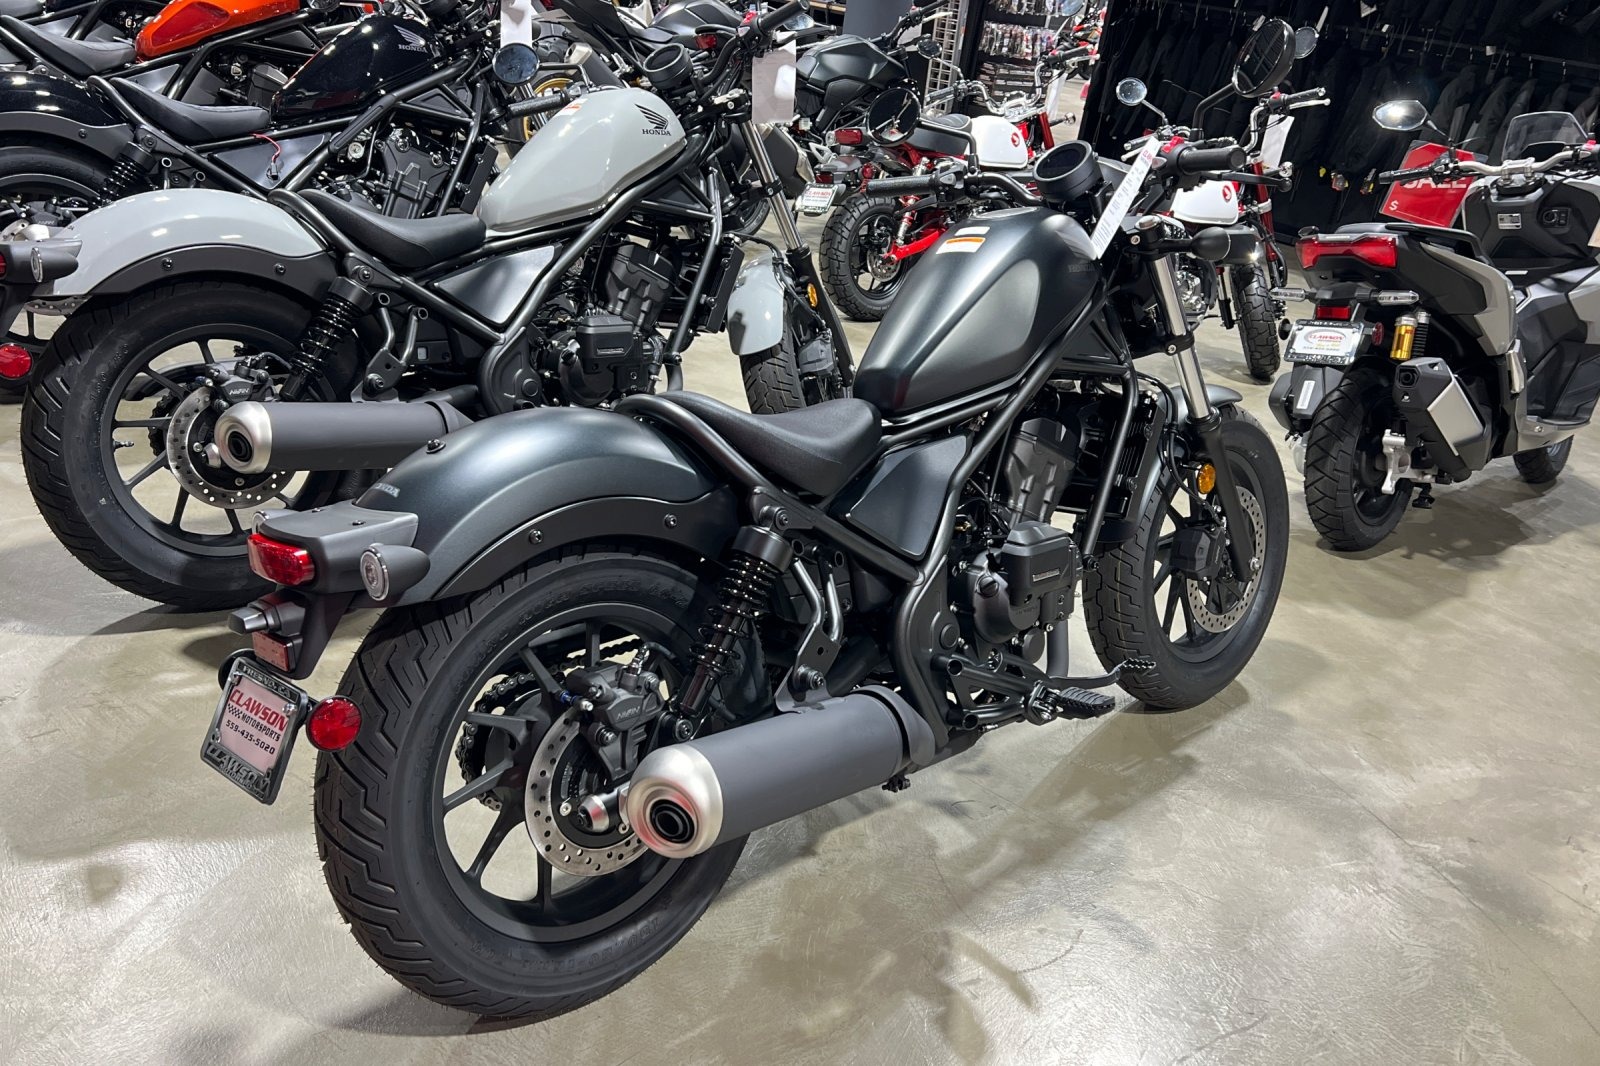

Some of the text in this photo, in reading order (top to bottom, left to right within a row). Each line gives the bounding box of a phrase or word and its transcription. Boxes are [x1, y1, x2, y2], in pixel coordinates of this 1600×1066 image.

[398, 44, 428, 53] HONDA
[1389, 200, 1399, 211] $
[277, 685, 291, 698] CA
[229, 689, 289, 732] CLAWSON
[225, 719, 276, 755] 559-435-5020
[241, 712, 281, 742] MOTORSPORTS
[206, 744, 271, 793] CLAWSON
